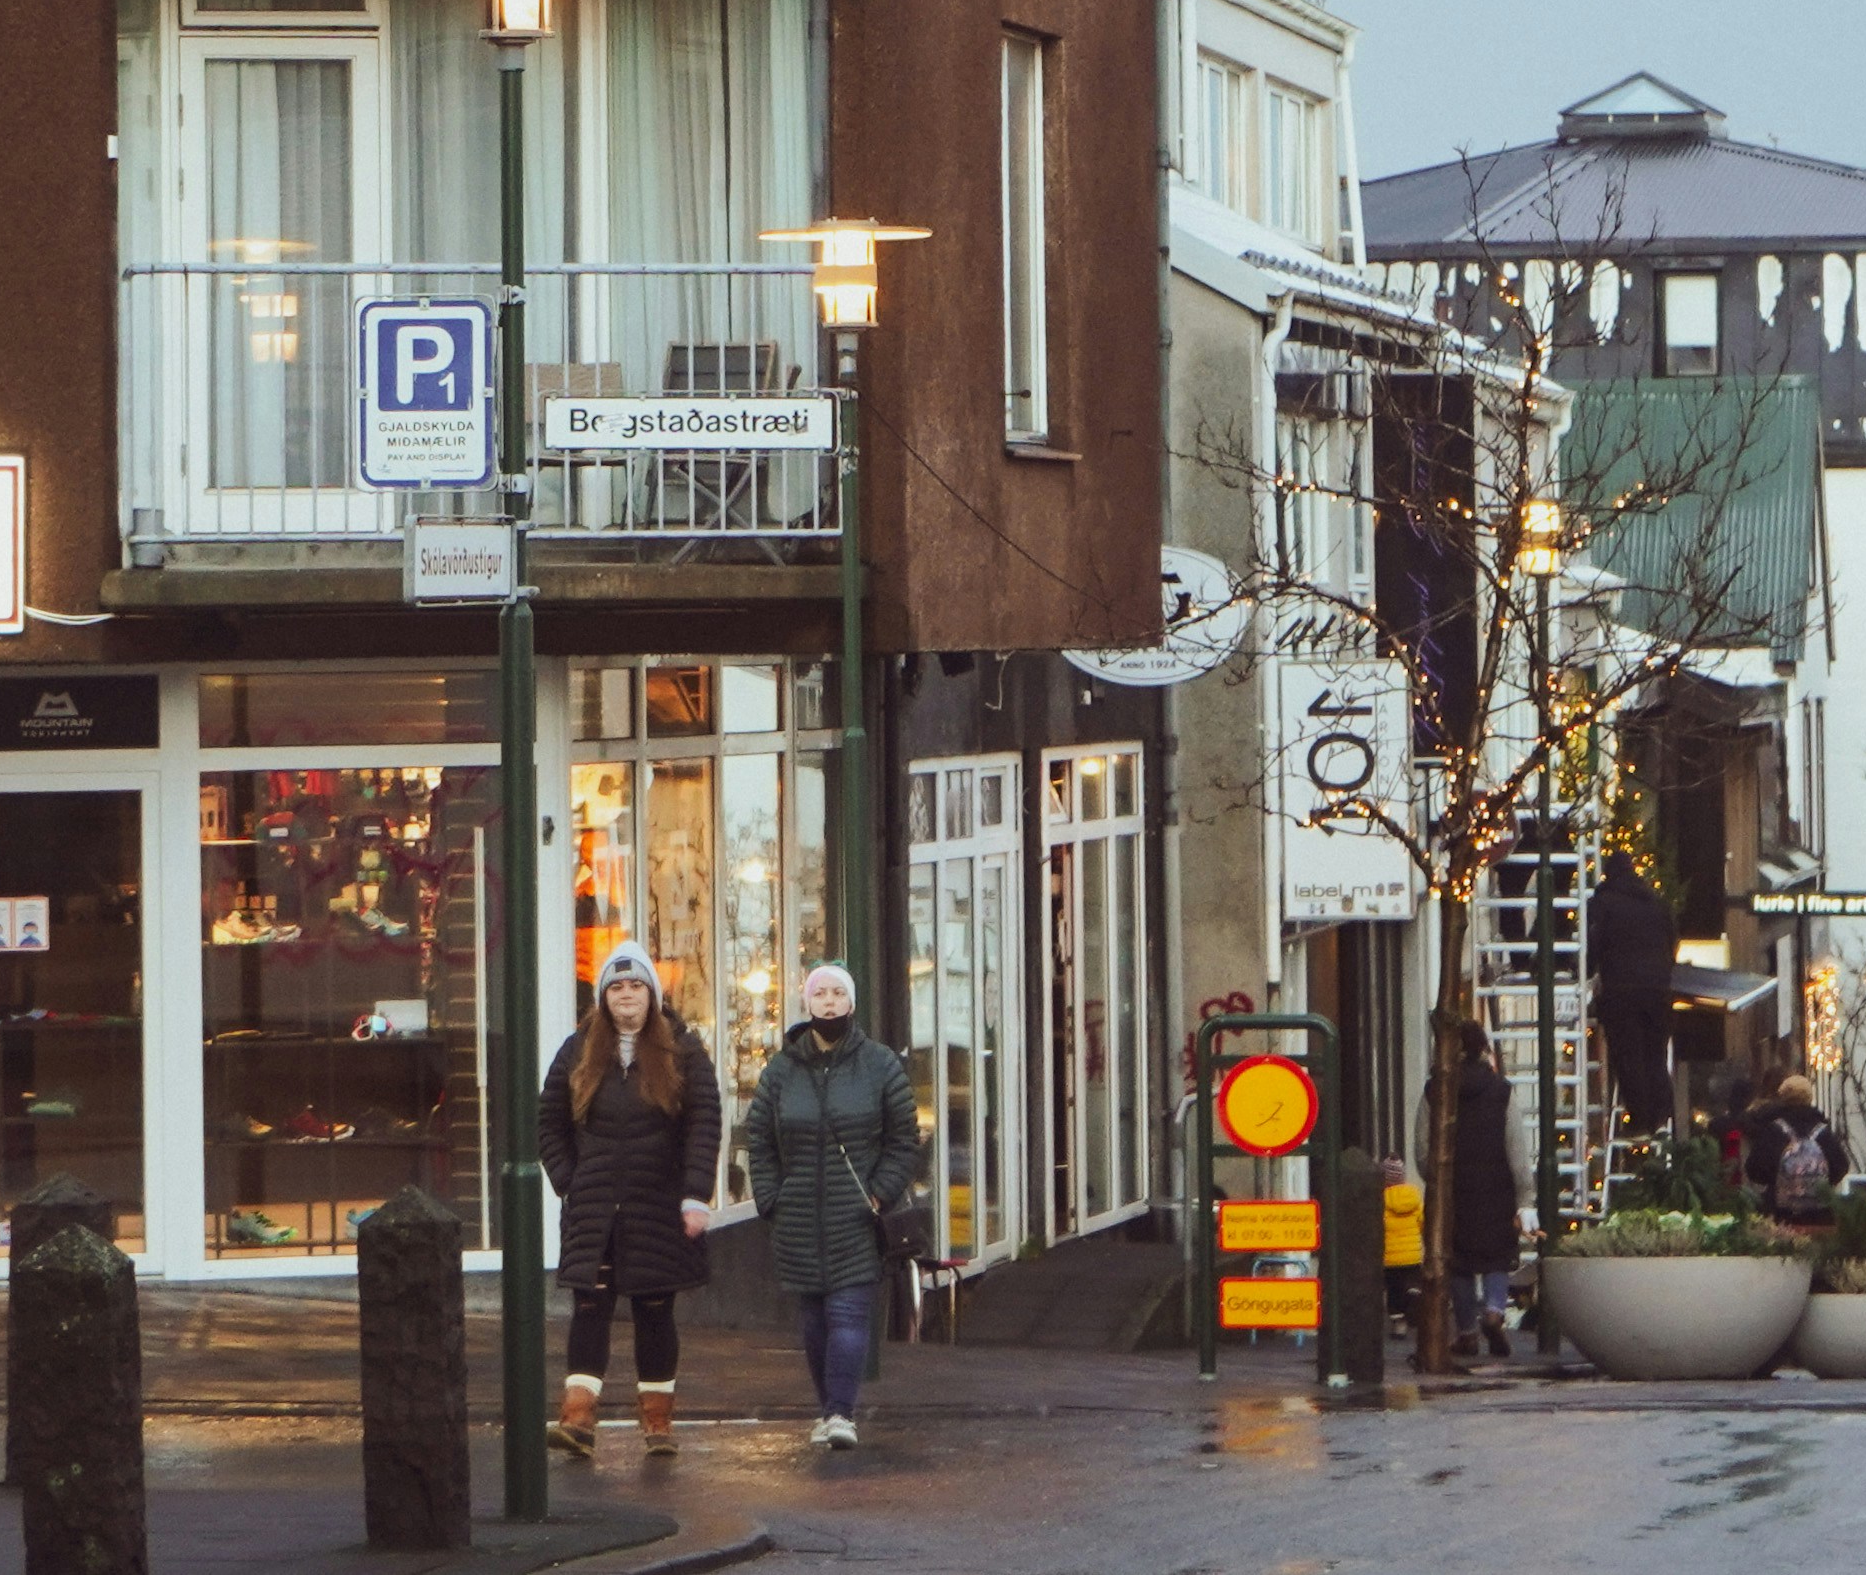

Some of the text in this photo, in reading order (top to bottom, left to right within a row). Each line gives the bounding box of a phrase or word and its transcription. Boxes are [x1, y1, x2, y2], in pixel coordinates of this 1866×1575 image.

[379, 421, 475, 432] GJALDSKYLDA
[406, 453, 426, 461] AND
[428, 453, 466, 461] DISPLAY
[420, 547, 502, 580] Skólavörðustígur
[1120, 659, 1176, 669] ANNO 1924
[20, 718, 93, 728] MOUNTAIN
[1807, 894, 1843, 913] fine
[1227, 1295, 1313, 1315] Göngugata
